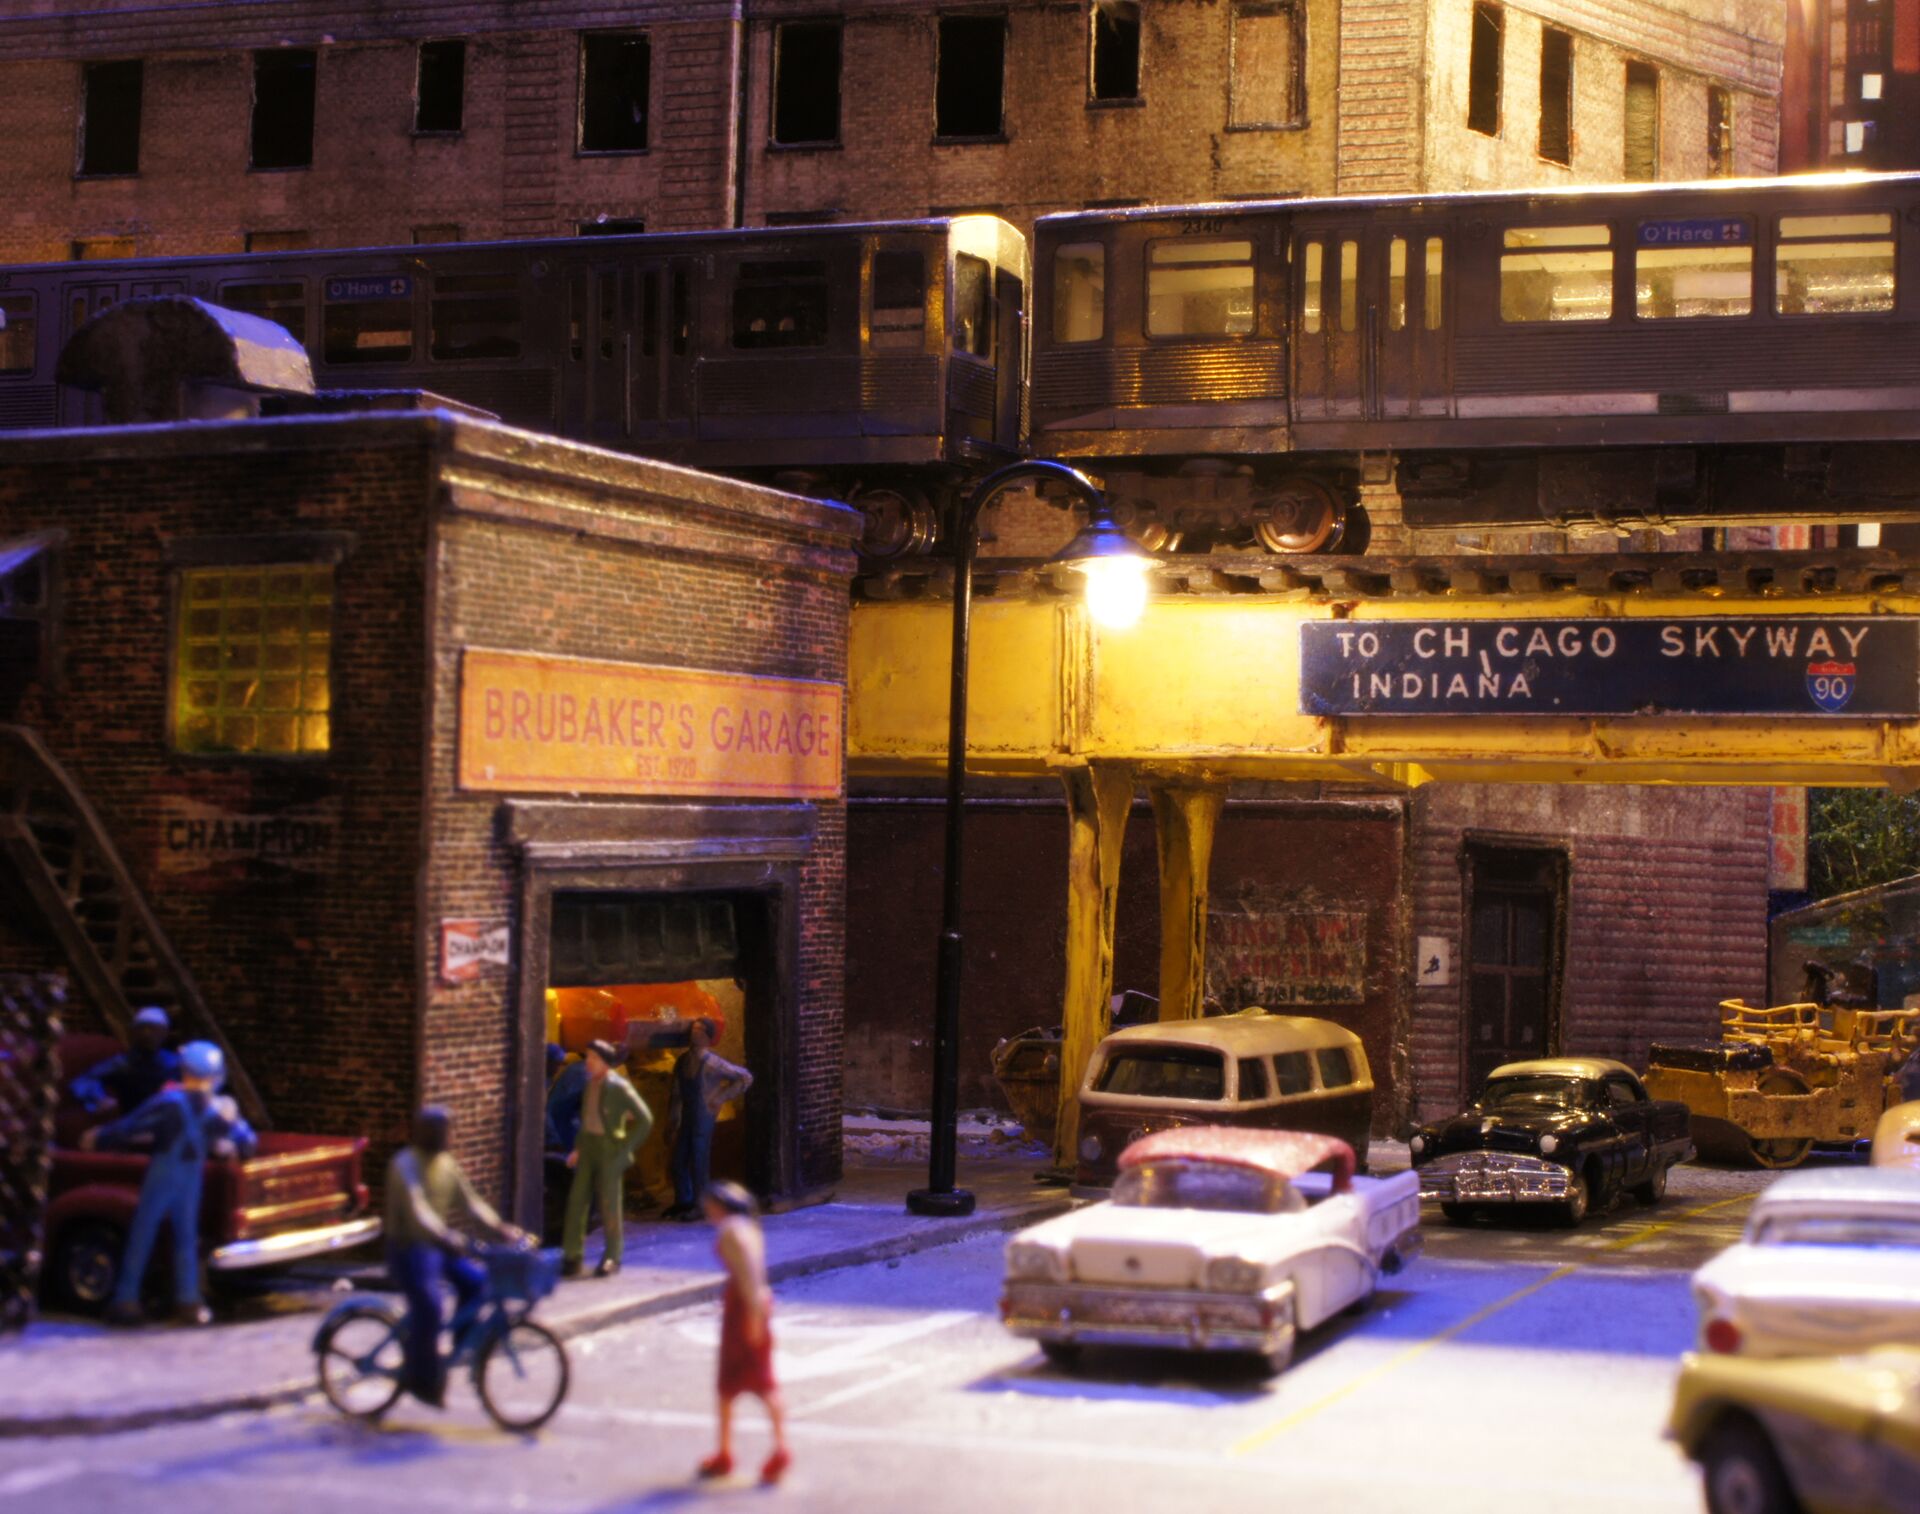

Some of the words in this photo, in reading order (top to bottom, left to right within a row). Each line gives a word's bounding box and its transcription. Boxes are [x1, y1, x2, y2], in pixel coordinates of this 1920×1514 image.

[1644, 226, 1714, 241] O'Hare
[330, 282, 384, 296] O'Hare
[1336, 632, 1380, 657] TO
[1661, 626, 1869, 657] SKYWAY
[1353, 673, 1532, 698] INDIANA
[1815, 677, 1847, 699] 90
[484, 688, 696, 750] BRUBAKER'S
[710, 706, 831, 757] GARAGE
